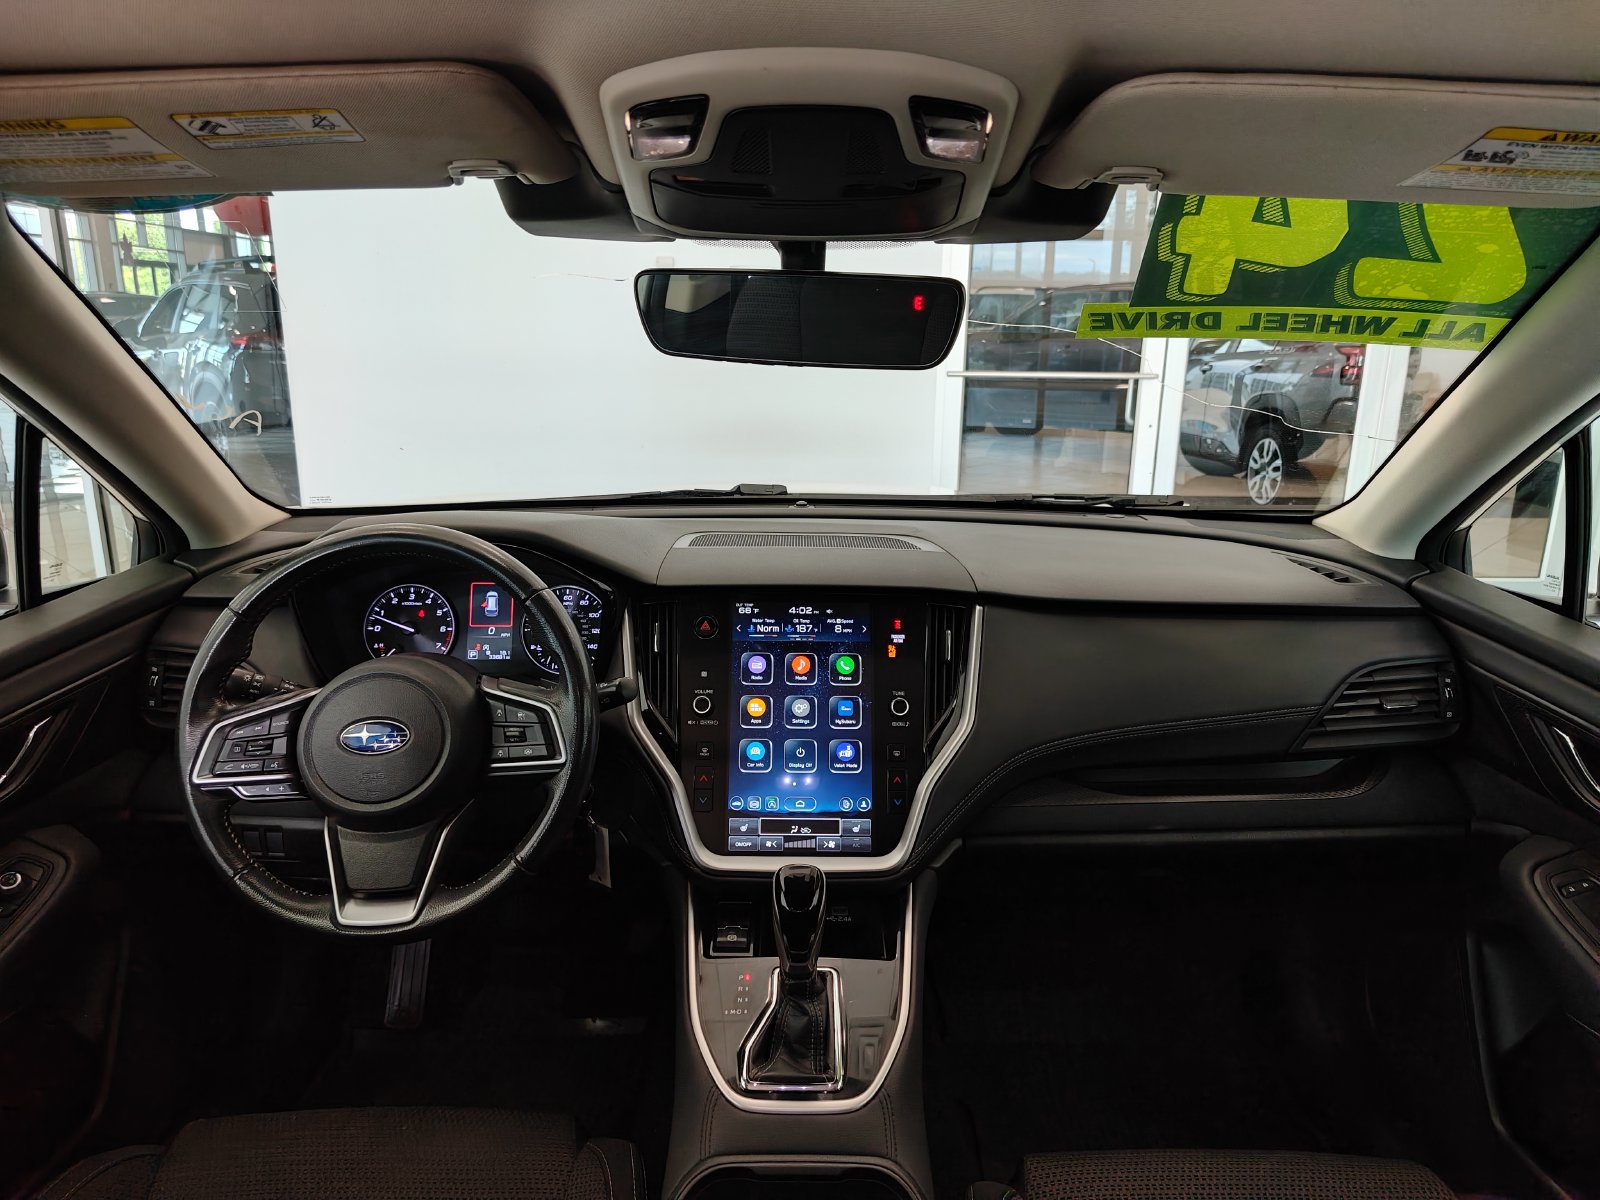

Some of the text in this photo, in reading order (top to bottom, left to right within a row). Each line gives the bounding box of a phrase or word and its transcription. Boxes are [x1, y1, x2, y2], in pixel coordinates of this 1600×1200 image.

[912, 295, 925, 311] E
[738, 606, 752, 614] 68
[788, 606, 813, 615] 4:02
[488, 626, 496, 635] 0
[756, 624, 780, 633] Norm
[795, 624, 813, 633] 187
[834, 624, 842, 633] 8
